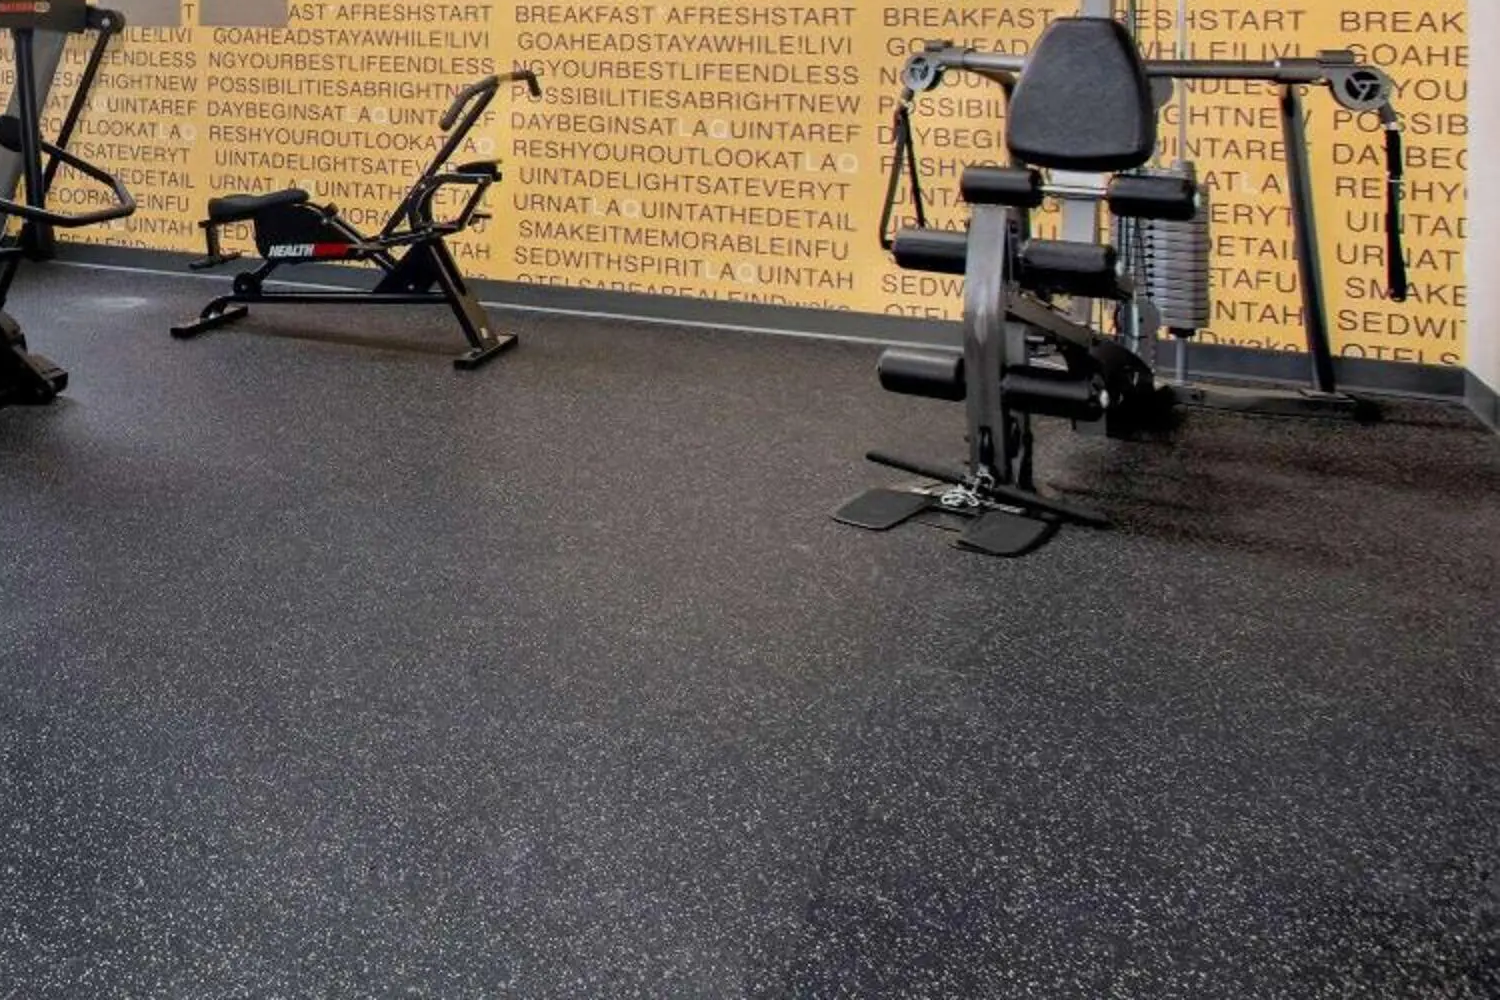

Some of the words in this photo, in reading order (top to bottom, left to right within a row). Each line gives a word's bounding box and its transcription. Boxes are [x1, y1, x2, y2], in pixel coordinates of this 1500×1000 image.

[337, 5, 491, 23] AFRESHSTART
[1339, 11, 1464, 33] BREAK
[209, 53, 494, 76] NGYOURBESTLIFEENDLESS
[519, 166, 850, 202] UINTADELIGHTSATEVERYT
[519, 219, 848, 261] SMAKEITMEMORABLEINFU
[1338, 309, 1467, 340] SEDWI
